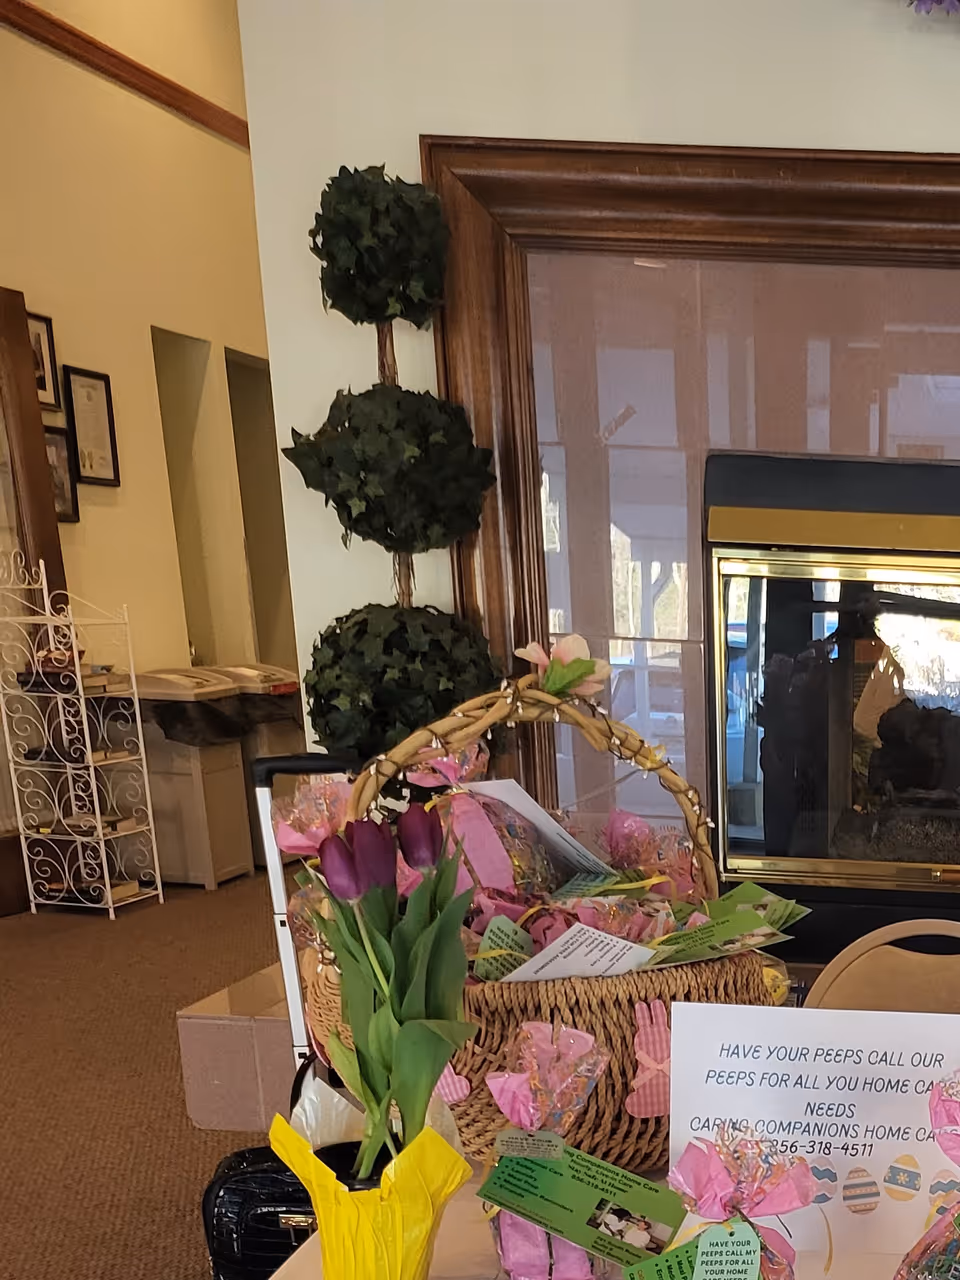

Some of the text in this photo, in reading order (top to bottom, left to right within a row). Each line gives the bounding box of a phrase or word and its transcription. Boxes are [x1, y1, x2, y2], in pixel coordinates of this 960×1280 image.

[719, 1043, 945, 1069] HAVE YOUR PEEPS CALL OUR
[705, 1069, 757, 1087] PEEPS
[759, 1072, 791, 1088] FOR
[793, 1074, 820, 1090] ALL
[825, 1075, 860, 1092] YOU
[862, 1077, 911, 1094] HOME
[804, 1101, 857, 1119] NEEDS
[754, 1119, 860, 1139] COMPANIONS
[863, 1124, 912, 1142] HOME
[576, 1153, 660, 1194] Companions Home Care
[618, 1178, 633, 1189] Care
[708, 1240, 730, 1248] HAVE
[701, 1250, 724, 1258] PEEPS
[677, 1260, 685, 1275] Meal
[700, 1259, 724, 1267] PEEPS
[704, 1268, 725, 1276] YOUR
